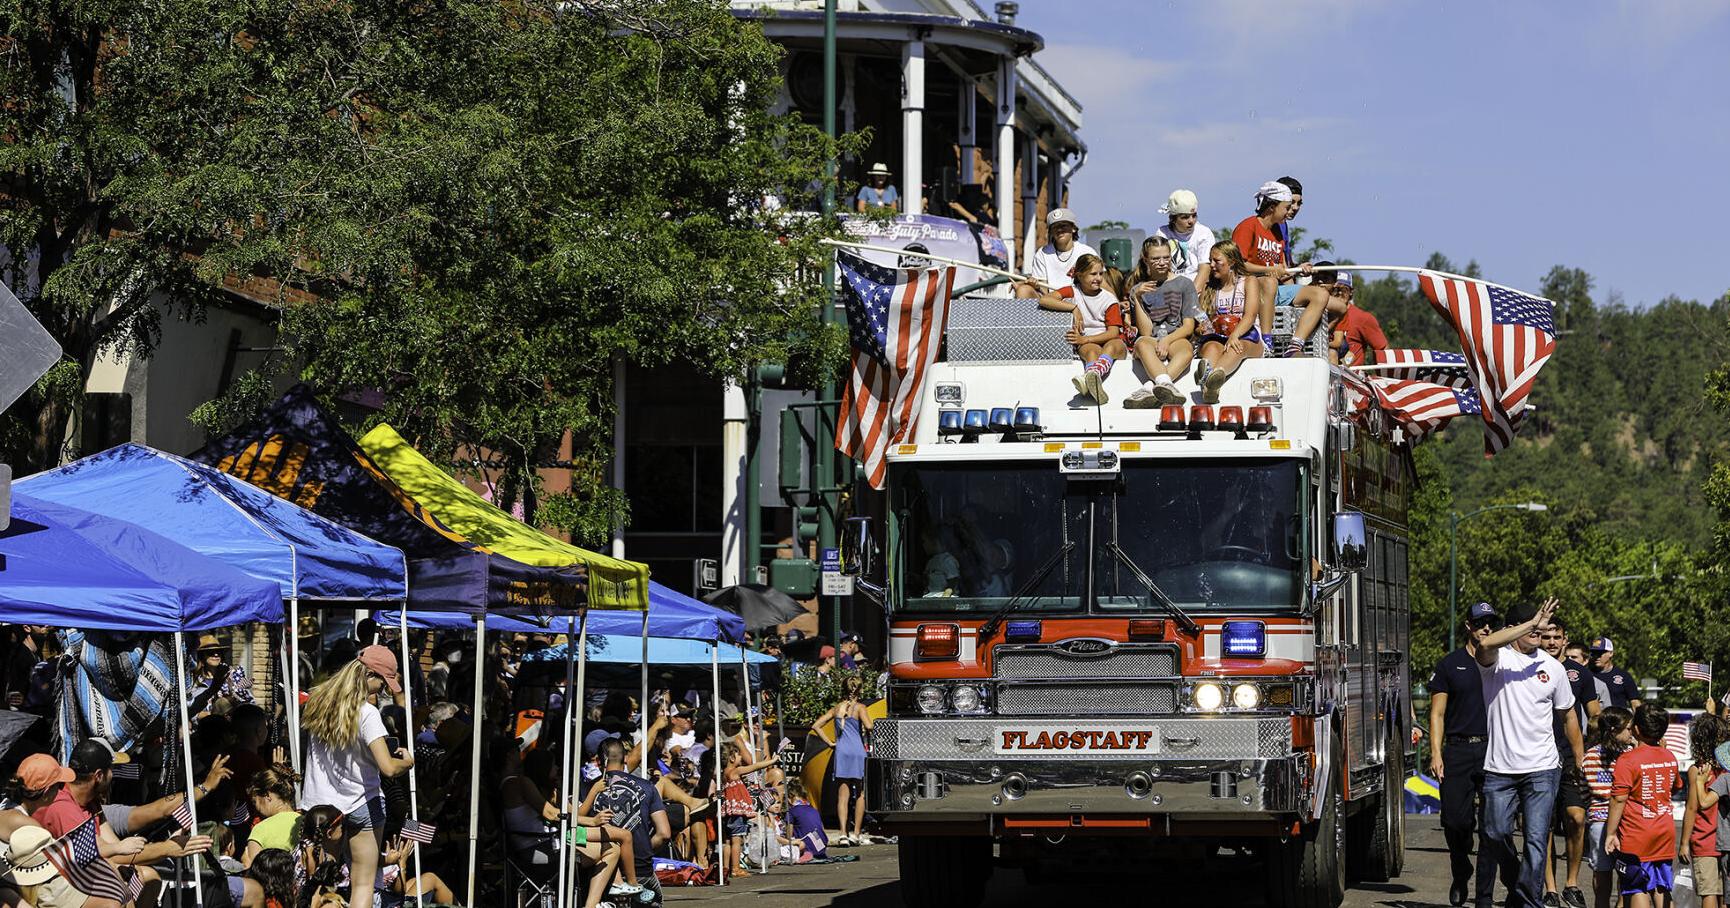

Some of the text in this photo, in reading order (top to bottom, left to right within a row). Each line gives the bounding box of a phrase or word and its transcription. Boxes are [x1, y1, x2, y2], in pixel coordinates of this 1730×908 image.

[889, 223, 920, 242] July
[921, 223, 959, 241] Parade
[1001, 730, 1153, 750] FLAGSTAFF
